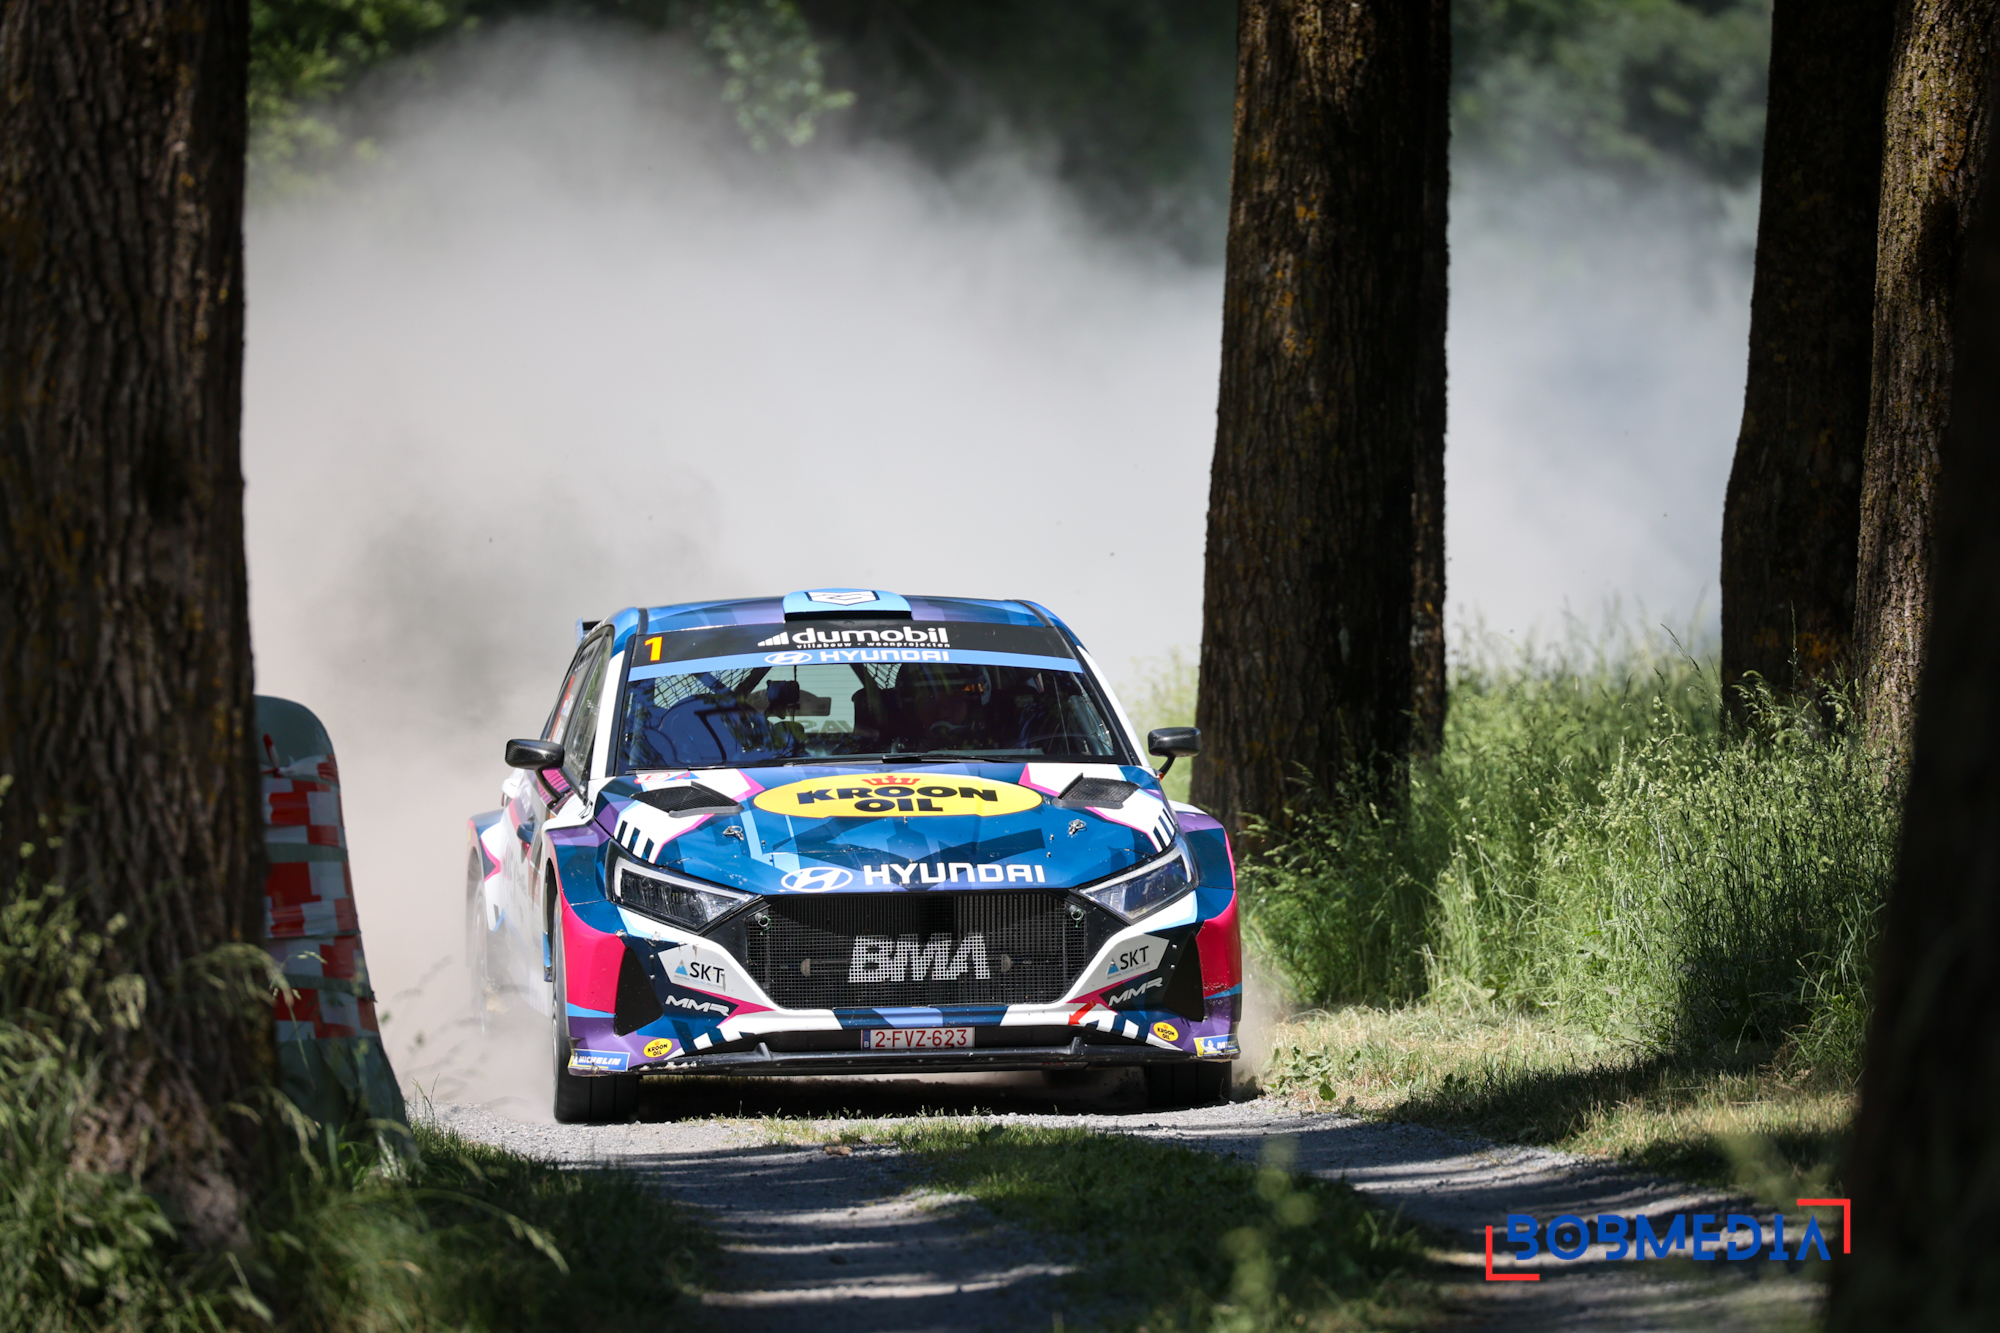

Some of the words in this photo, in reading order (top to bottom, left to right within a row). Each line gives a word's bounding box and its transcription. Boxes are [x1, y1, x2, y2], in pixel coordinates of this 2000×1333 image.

[792, 626, 949, 643] dumobil
[644, 636, 663, 662] 1
[820, 650, 950, 662] HYUNDAI
[796, 786, 999, 805] KROON
[854, 798, 944, 812] OIL
[863, 862, 1046, 886] HYUNDAI
[1120, 945, 1149, 970] SKT
[690, 961, 725, 984] SKT
[1108, 976, 1163, 1007] MMR
[665, 995, 730, 1017] MMR
[864, 1040, 869, 1048] B
[875, 1029, 967, 1048] 2-FVZ-623
[1157, 1027, 1175, 1036] KROON
[647, 1043, 668, 1053] KROON
[578, 1055, 622, 1066] MICHELIN
